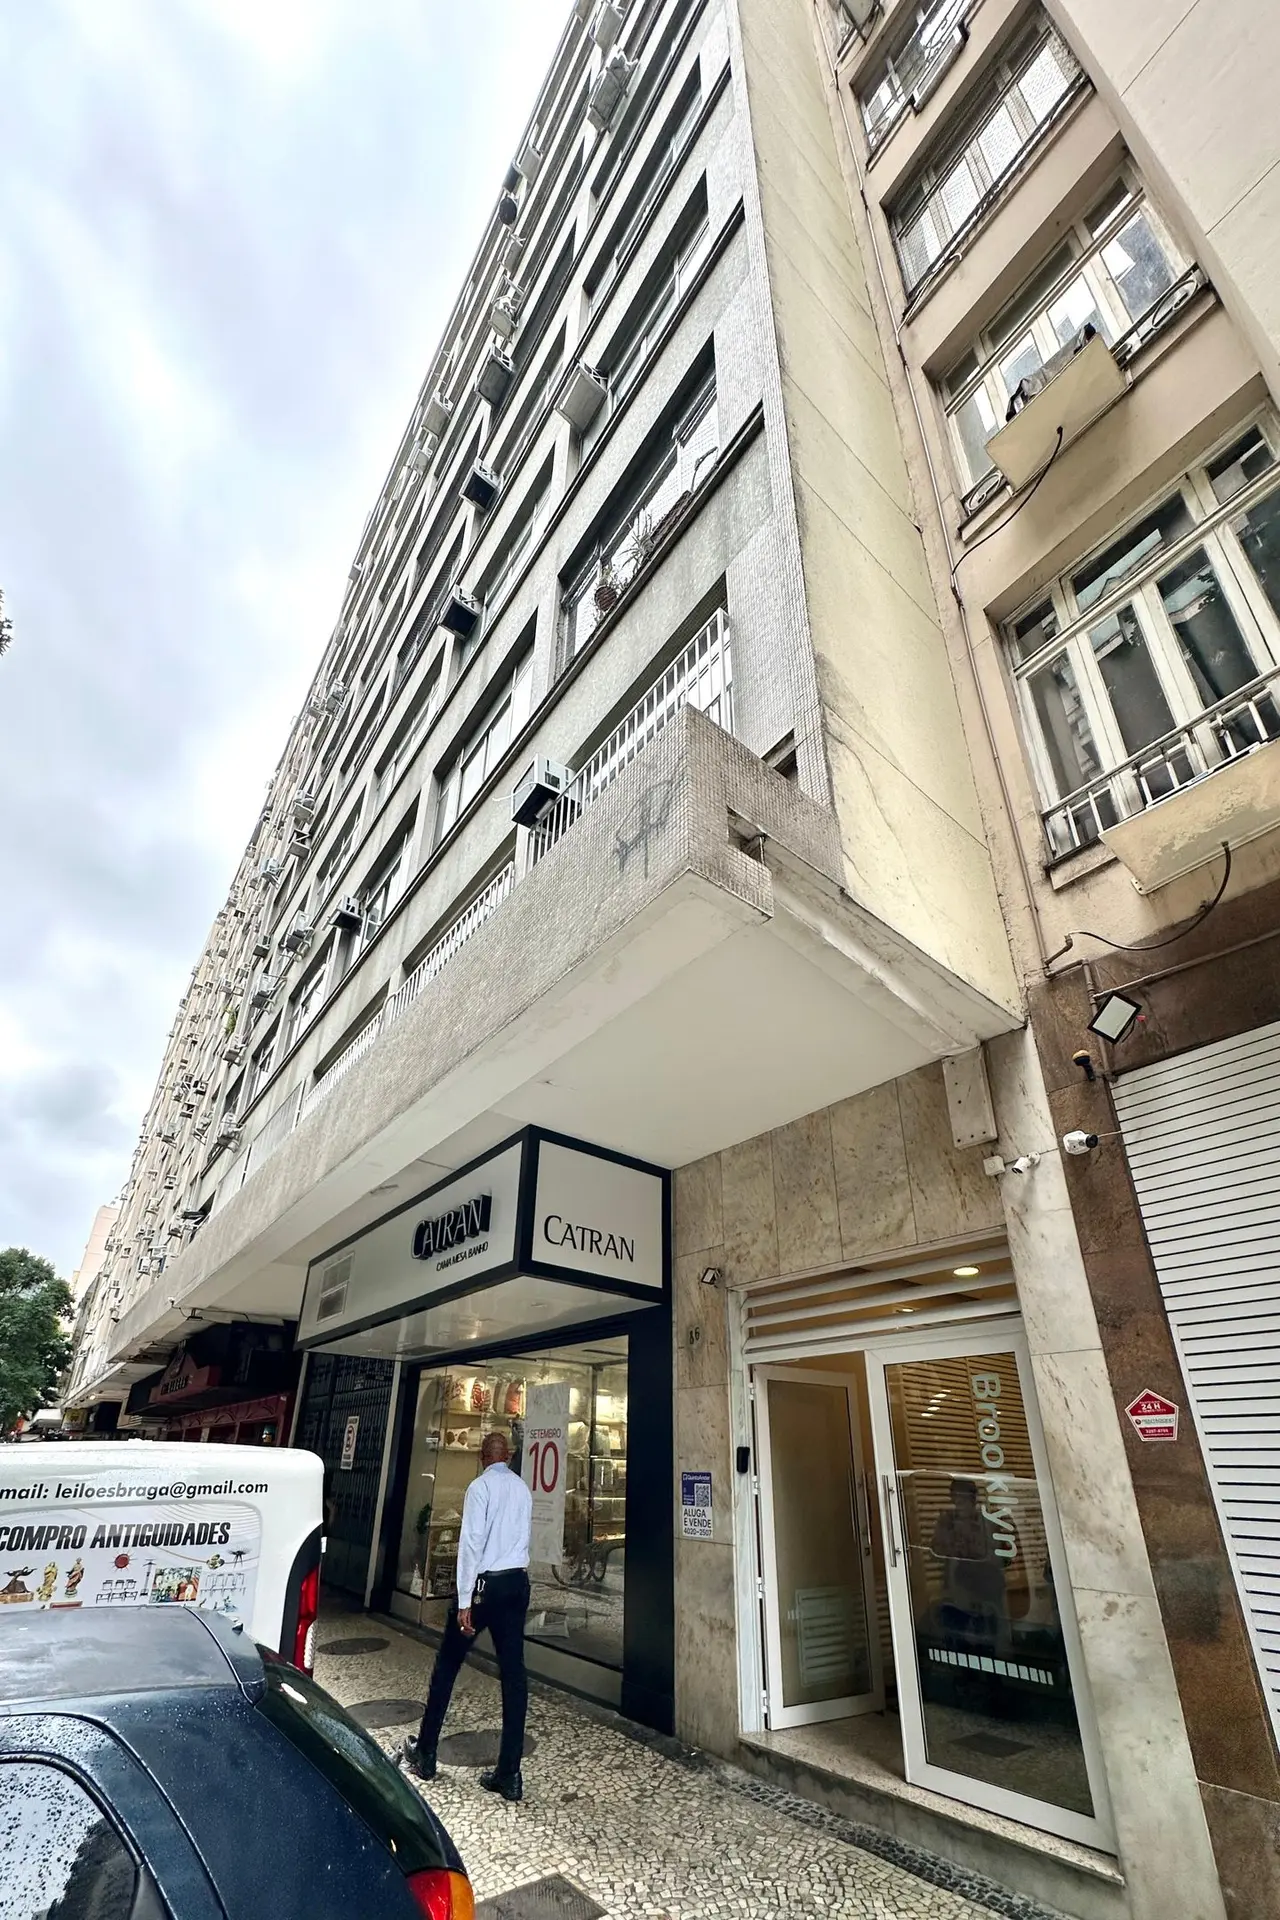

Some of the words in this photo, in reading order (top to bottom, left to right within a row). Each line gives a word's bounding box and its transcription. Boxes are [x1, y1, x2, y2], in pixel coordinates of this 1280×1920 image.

[411, 1194, 492, 1260] CATRAN
[543, 1215, 635, 1262] CATRAN
[436, 1256, 452, 1271] CAMA
[452, 1250, 467, 1265] MESA
[467, 1241, 489, 1259] BANHO
[1153, 1402, 1161, 1410] H
[529, 1428, 561, 1439] SETEMBRO
[529, 1441, 559, 1493] 10
[971, 1372, 1019, 1558] Brooklyn
[0, 1483, 49, 1499] mail:
[55, 1480, 269, 1500] leiloesbraga@gmail.com
[683, 1508, 707, 1518] ALUGA
[683, 1517, 688, 1526] E
[689, 1518, 712, 1528] VENDE
[0, 1524, 88, 1552] COMPRO
[90, 1522, 231, 1549] ANTIGUIDADES
